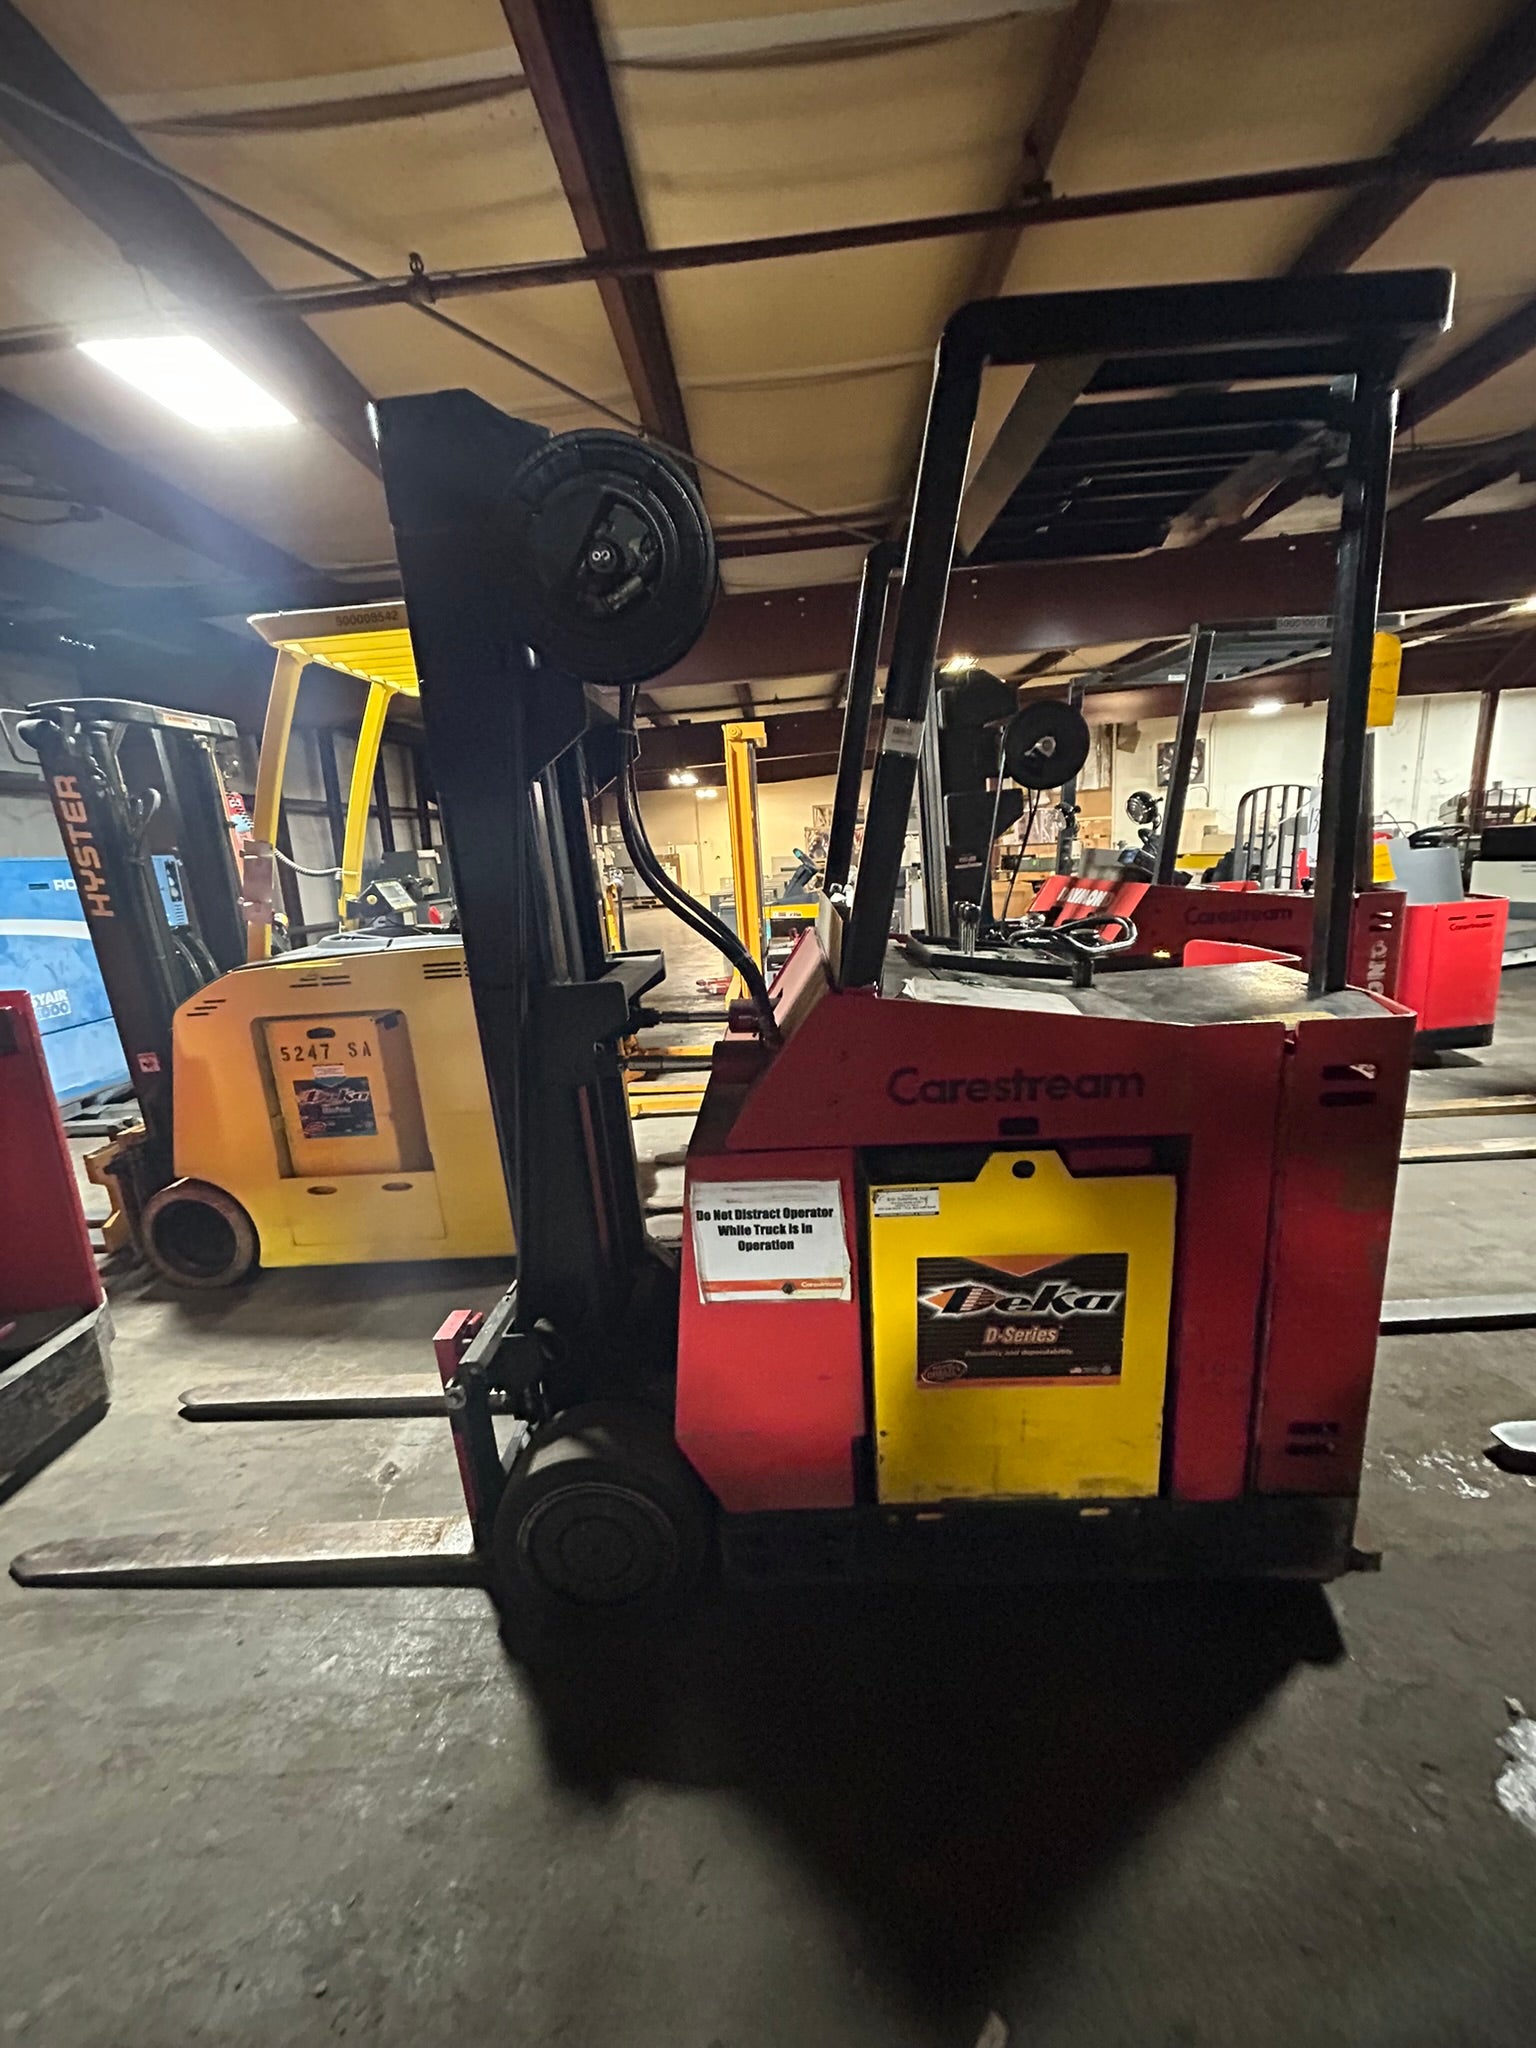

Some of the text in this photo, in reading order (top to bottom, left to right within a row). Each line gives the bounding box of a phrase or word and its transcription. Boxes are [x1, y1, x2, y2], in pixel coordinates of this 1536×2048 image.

[53, 775, 115, 918] HYSTER
[280, 1040, 372, 1062] 5247 SA
[887, 1067, 1147, 1107] Carestream
[696, 1207, 834, 1222] Do Not Distract Operator
[717, 1225, 752, 1236] While
[753, 1224, 787, 1236] Truck
[738, 1239, 795, 1253] Operation
[918, 1282, 1122, 1318] Deka
[983, 1325, 1059, 1345] D-Series
